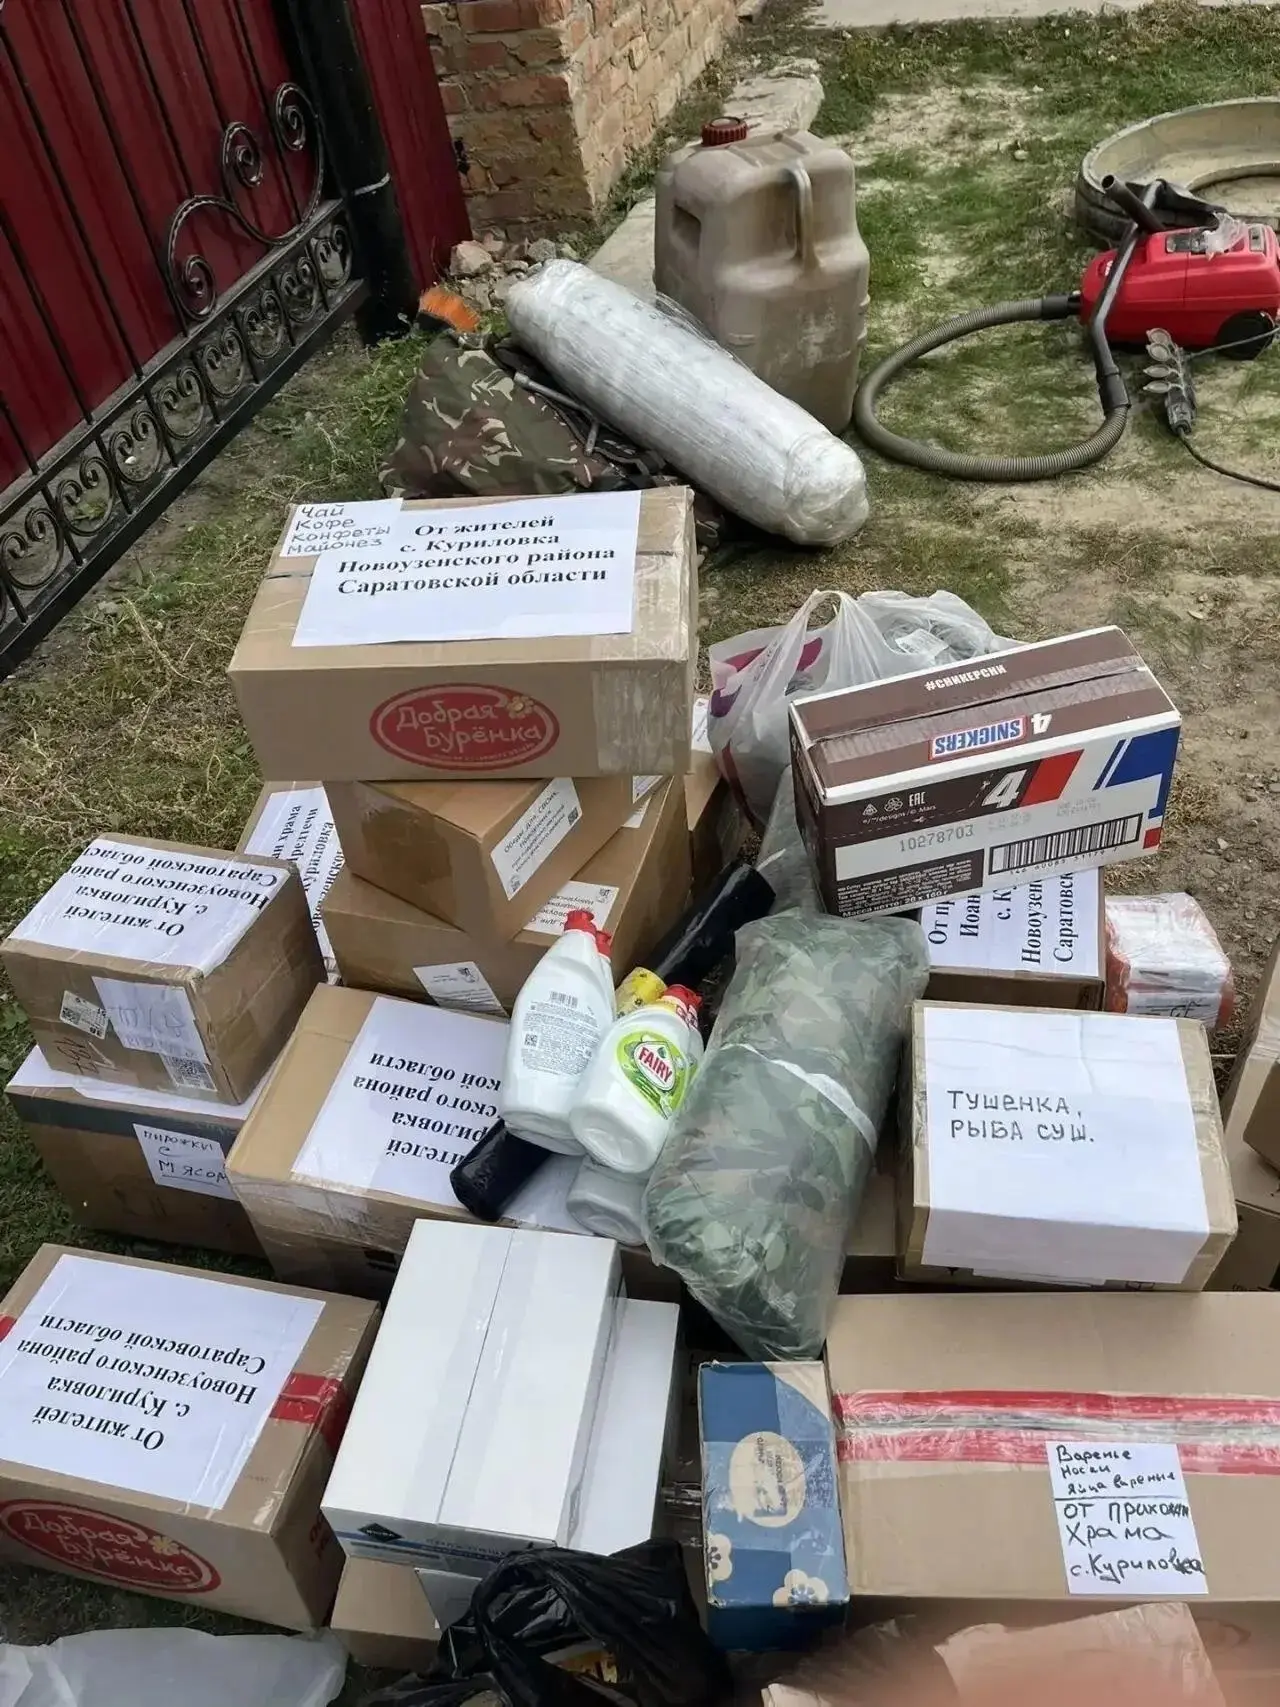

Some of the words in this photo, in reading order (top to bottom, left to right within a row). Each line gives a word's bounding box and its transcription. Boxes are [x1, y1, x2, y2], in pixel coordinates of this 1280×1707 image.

[295, 518, 356, 532] Кофе
[301, 504, 345, 519] Чай
[414, 524, 448, 537] От
[454, 515, 555, 534] жителей
[400, 543, 416, 552] с.
[427, 535, 560, 552] Куриловка
[338, 554, 519, 574] Новоузенского
[527, 549, 616, 564] района
[338, 572, 499, 596] Саратовской
[507, 569, 607, 585] области
[396, 701, 498, 730] Добрая
[1031, 713, 1052, 734] 4
[423, 726, 542, 754] Бурёнка
[935, 720, 1020, 754] SNICKERS
[981, 769, 1028, 809] 4
[278, 805, 302, 841] храма
[899, 823, 975, 852] 10278703
[148, 858, 278, 887] Саратовской
[76, 886, 187, 915] Куриловка
[121, 874, 270, 910] Новоузенского
[64, 905, 154, 928] жителей
[195, 905, 208, 915] с.
[997, 907, 1011, 920] с.
[157, 923, 185, 937] От
[928, 920, 949, 945] От
[369, 1053, 455, 1082] области
[639, 1047, 672, 1083] FAIRY
[353, 1076, 433, 1102] района
[951, 1119, 1023, 1140] РЫБА
[1037, 1122, 1095, 1143] СУШ.
[40, 1315, 122, 1342] области
[17, 1339, 96, 1364] района
[127, 1333, 266, 1375] Саратовской
[96, 1355, 257, 1405] Новоузенского
[47, 1376, 168, 1418] Куриловка
[175, 1402, 190, 1417] с.
[32, 1405, 127, 1437] жителей
[133, 1430, 164, 1451] От
[1056, 1445, 1132, 1464] Варенье
[21, 1512, 140, 1548] Добрая
